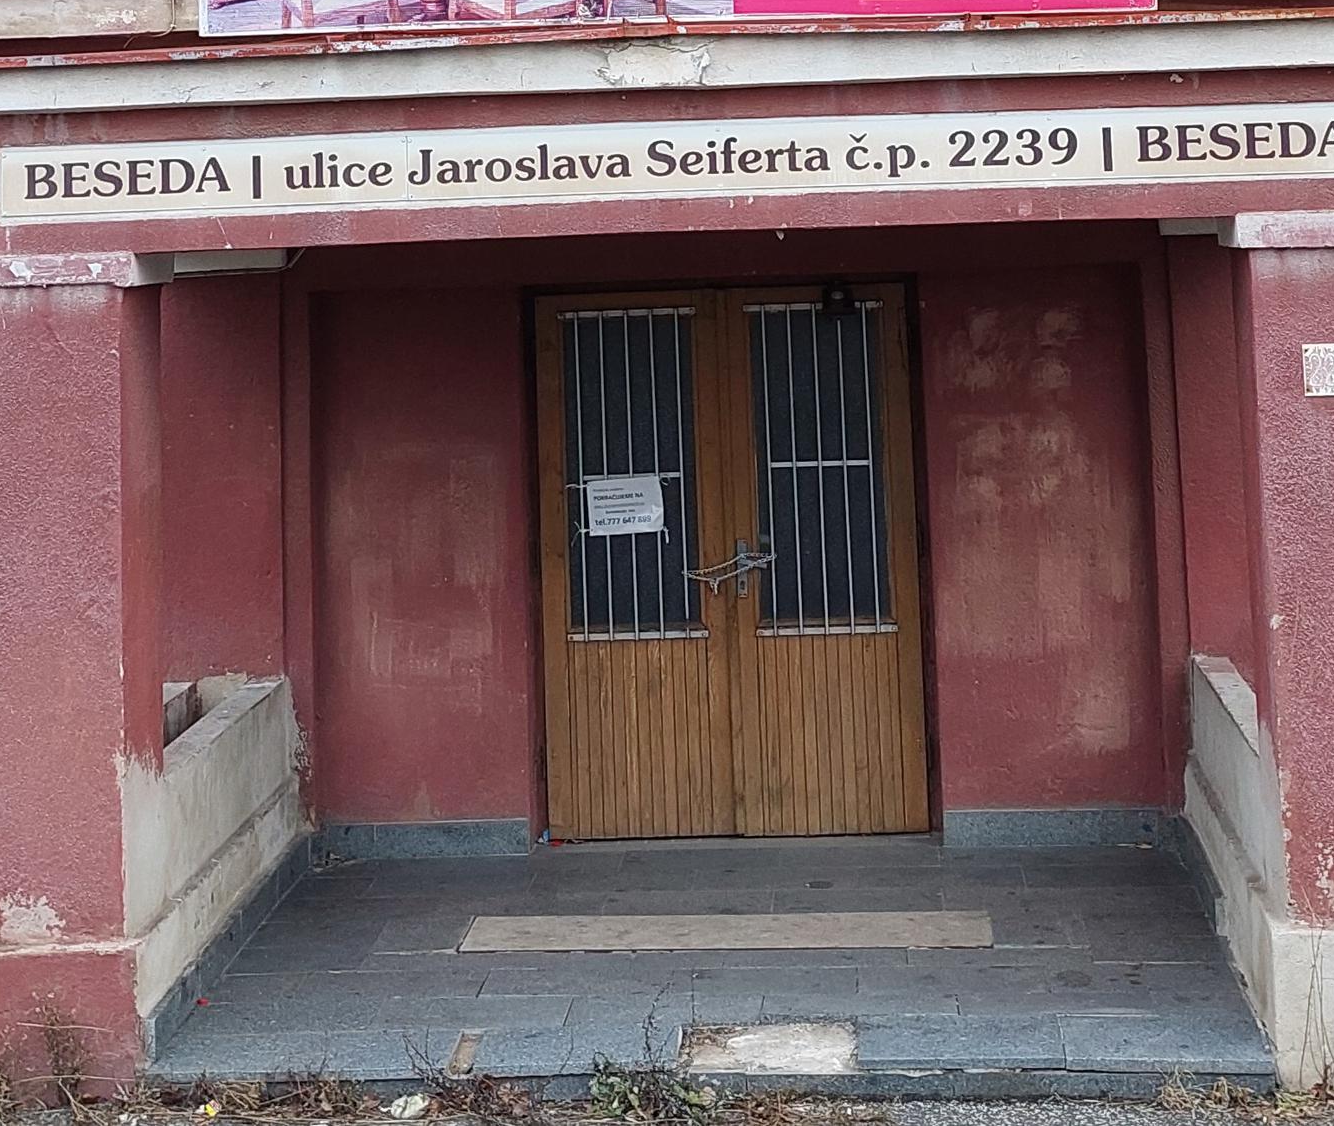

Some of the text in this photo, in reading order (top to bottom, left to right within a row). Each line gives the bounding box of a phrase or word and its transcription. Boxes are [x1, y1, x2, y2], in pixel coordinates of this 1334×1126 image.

[24, 156, 231, 200] BESEDA
[283, 151, 393, 191] ulice
[407, 143, 632, 186] Jaroslava
[645, 136, 830, 177] Seiferta
[845, 133, 930, 178] č.p.
[947, 128, 1078, 169] 2239
